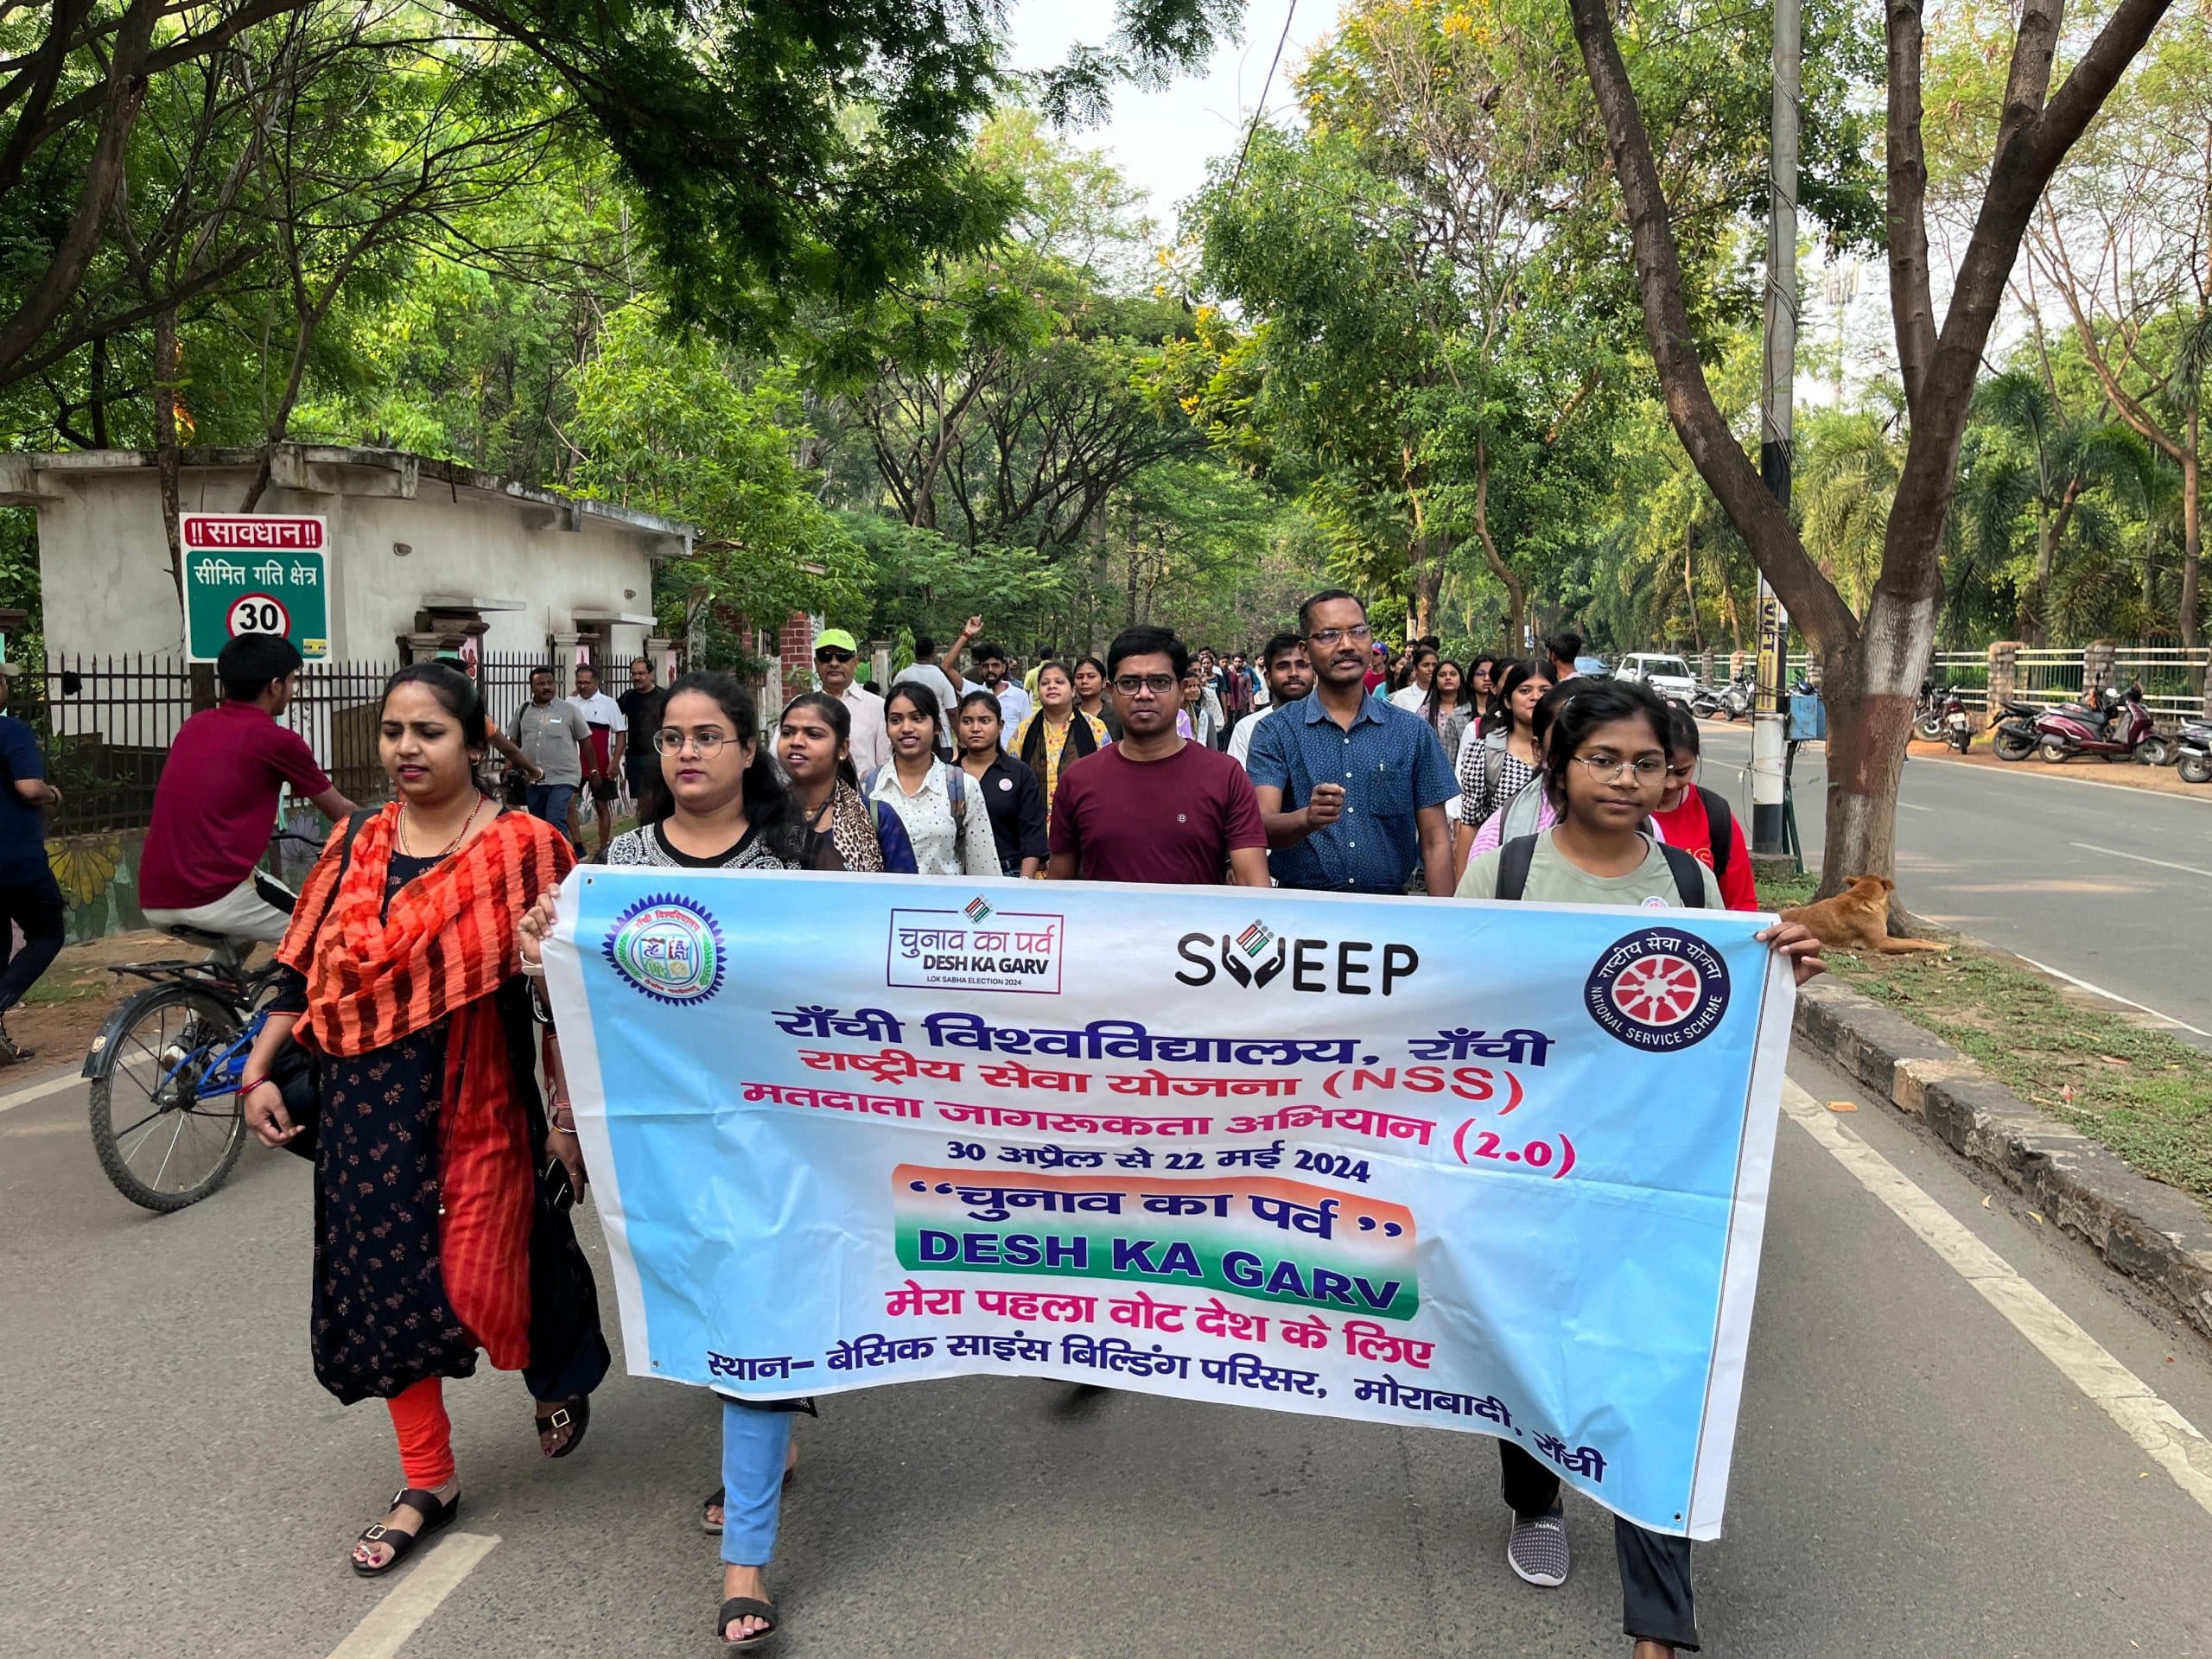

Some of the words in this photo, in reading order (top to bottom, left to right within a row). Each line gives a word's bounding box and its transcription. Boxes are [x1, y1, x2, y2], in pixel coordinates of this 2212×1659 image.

[194, 558, 245, 585] सीमित
[252, 559, 283, 586] गति
[290, 560, 317, 586] क्षेत्र
[239, 603, 278, 630] 30
[899, 928, 968, 958] चुनाव
[973, 931, 1010, 953] का
[1014, 925, 1055, 954] पर्व
[923, 955, 968, 971] DESH
[971, 957, 996, 973] KA
[999, 958, 1049, 975] GARV
[1646, 932, 1681, 952] सेवा
[1687, 944, 1722, 979] योजना
[771, 1005, 906, 1043] राँची
[921, 1012, 1380, 1065] विश्वविद्यालय,
[1408, 1027, 1555, 1066] राँची
[1591, 987, 1621, 1033] NATIONAL
[1626, 1027, 1682, 1046] SERVICE
[1683, 995, 1723, 1039] SCHEME
[798, 1048, 965, 1084] राष्ट्रीय
[978, 1060, 1092, 1092] सेवा
[1105, 1069, 1303, 1096] योजना
[1322, 1065, 1524, 1116] (NSS)
[740, 1082, 924, 1118] मतदाता
[934, 1101, 1214, 1135] जागरूकता
[1224, 1104, 1437, 1145] अभियान
[1452, 1118, 1576, 1179] (2.0)
[947, 1141, 986, 1160] 30
[996, 1144, 1108, 1169] अप्रैल
[1113, 1147, 1154, 1169] से
[1165, 1152, 1205, 1169] 22
[1217, 1140, 1286, 1168] मई
[1295, 1149, 1371, 1183] 2024
[1142, 1193, 1233, 1217] का
[918, 1230, 1089, 1268] DESH
[1112, 1237, 1205, 1278] KA
[1220, 1250, 1402, 1311] GARV
[885, 1279, 964, 1319] मेरा
[976, 1288, 1099, 1323] पहला
[1109, 1290, 1188, 1333] वोट
[1195, 1297, 1269, 1343] देश
[1280, 1312, 1333, 1351] के
[1341, 1319, 1436, 1370] लिए
[826, 1333, 938, 1371] बेसिक
[946, 1330, 1052, 1362] साइंस
[1060, 1334, 1192, 1379] बिल्डिंग
[1199, 1352, 1327, 1399] परिसर,
[1354, 1374, 1523, 1437] मोराबादी,
[1532, 1430, 1607, 1483] राँची
